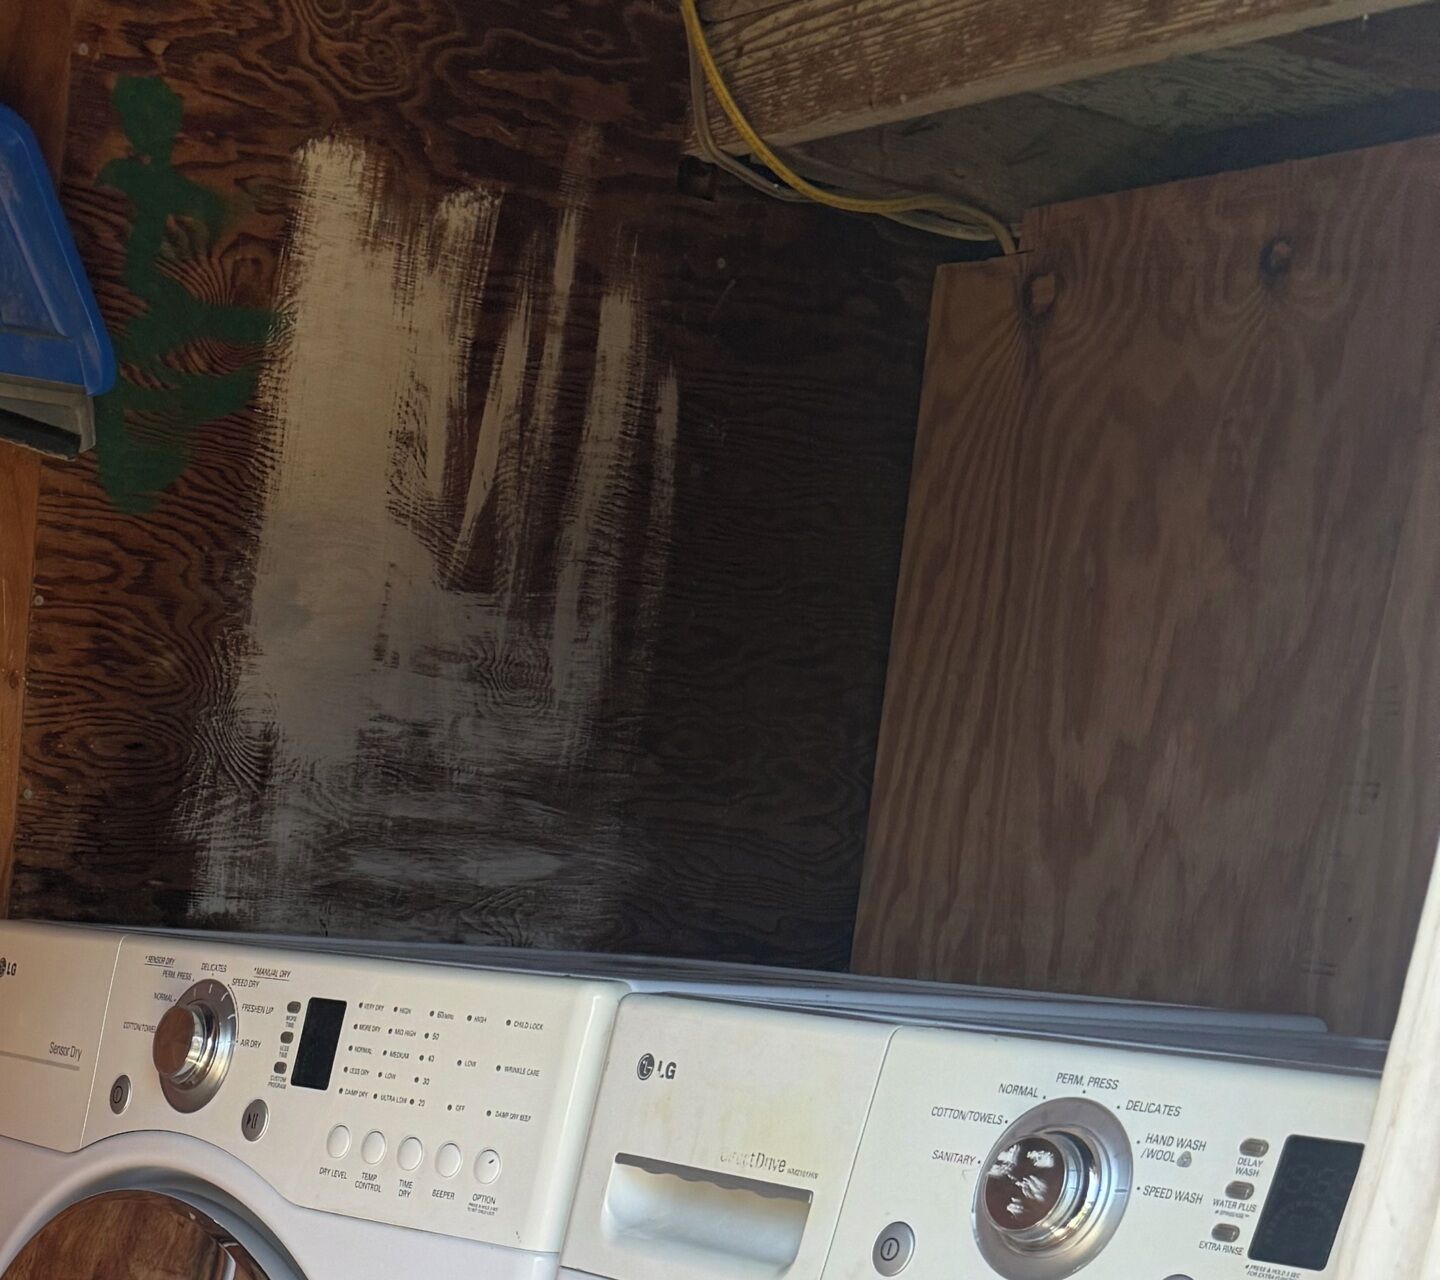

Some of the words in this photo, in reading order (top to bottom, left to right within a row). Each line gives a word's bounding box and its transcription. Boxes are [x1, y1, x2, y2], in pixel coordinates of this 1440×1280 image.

[165, 958, 176, 966] DRY
[201, 963, 227, 973] DELICATES
[6, 962, 17, 976] LG
[255, 967, 280, 977] MANUAL
[279, 971, 291, 979] DRY
[176, 972, 192, 981] PRESS
[232, 978, 249, 987] SPEED
[248, 980, 260, 989] DRY
[242, 1003, 266, 1014] FRESHEN
[265, 1006, 274, 1015] UP
[514, 1020, 529, 1029] CHILD
[529, 1022, 544, 1031] LOCK
[239, 1039, 248, 1048] AIR
[247, 1040, 261, 1048] DRY
[49, 1041, 70, 1056] Sensor
[69, 1045, 82, 1061] Dry
[360, 1068, 370, 1076] DRY
[504, 1066, 526, 1075] WRINKLE
[526, 1068, 540, 1077] CARE
[657, 1060, 677, 1080] LG
[1056, 1072, 1085, 1088] PERM.
[1086, 1077, 1120, 1090] PRESS
[358, 1090, 369, 1098] DRY
[998, 1083, 1039, 1098] NORMAL
[1125, 1100, 1182, 1117] DELICATES
[931, 1105, 1004, 1125] COTTON/TOWELS
[1145, 1133, 1175, 1147] HAND
[1175, 1138, 1207, 1152] WASH
[931, 1150, 977, 1166] SANITARY
[1140, 1148, 1176, 1163] /WOOL
[1237, 1157, 1264, 1168] DELAY
[319, 1166, 331, 1176] DRY
[330, 1169, 348, 1180] LEVEL
[361, 1172, 378, 1182] TEMP
[1235, 1167, 1260, 1178] WASH
[354, 1180, 381, 1193] CONTROL
[399, 1179, 413, 1189] TIME
[398, 1188, 411, 1198] DRY
[431, 1189, 456, 1200] BEEPER
[472, 1193, 497, 1205] OPTION
[1142, 1185, 1174, 1201] SPEED
[1174, 1190, 1205, 1205] WASH
[1212, 1199, 1238, 1211] WATER
[1237, 1202, 1258, 1213] PLUS
[1199, 1241, 1221, 1253] EXTRA
[1221, 1244, 1245, 1256] RINSE
